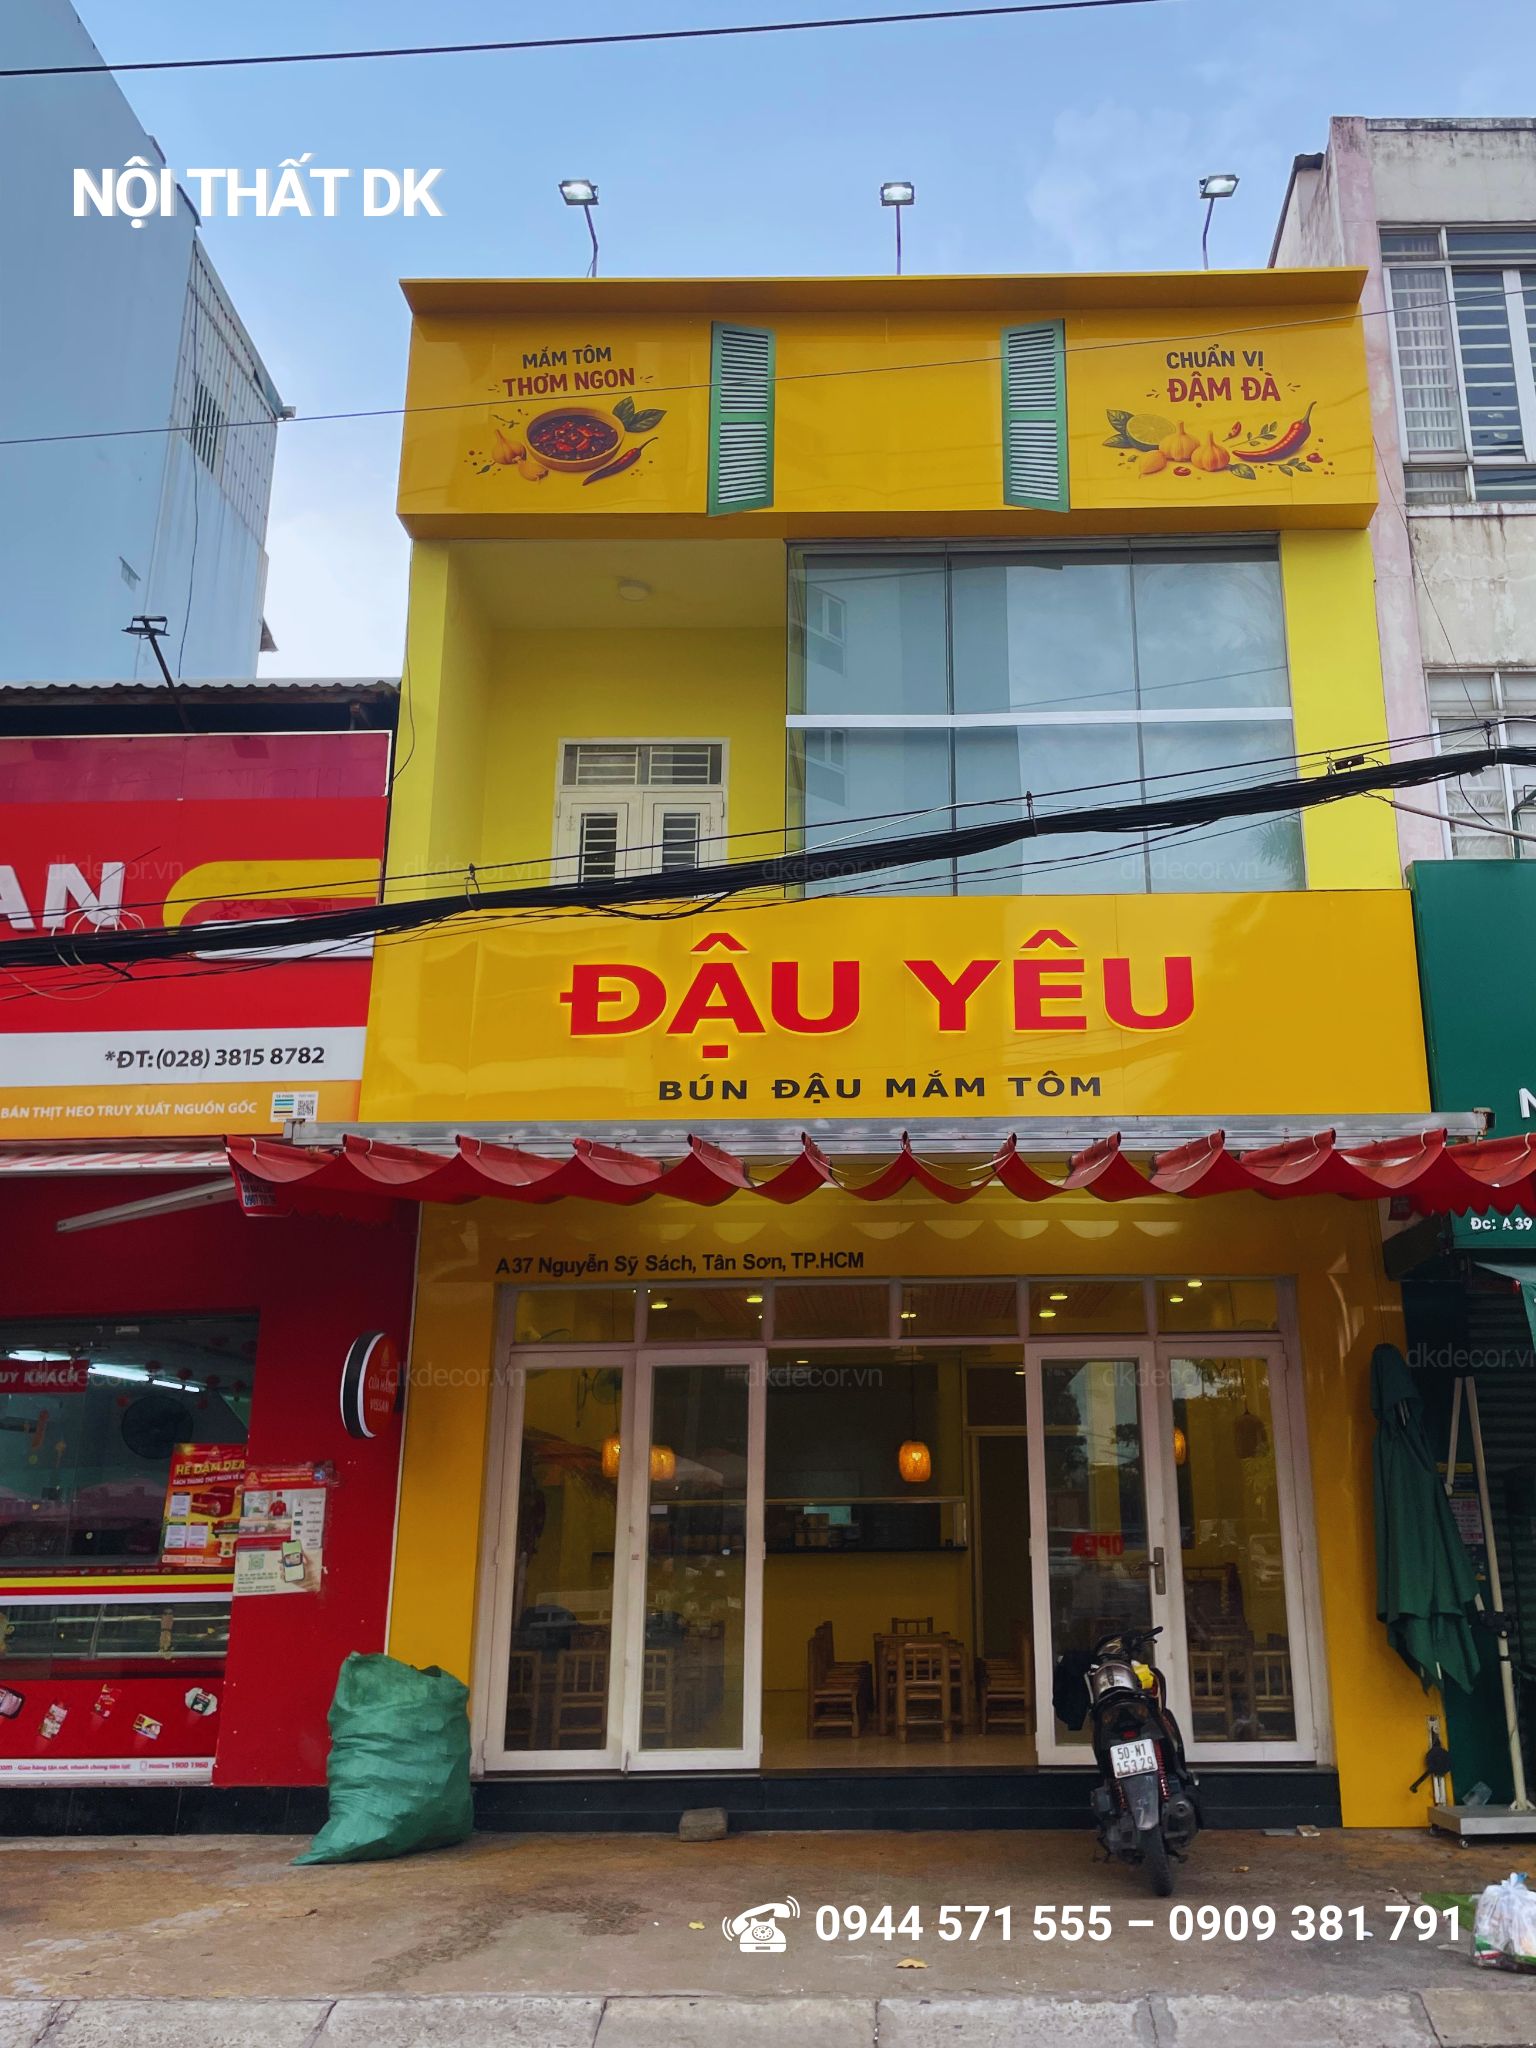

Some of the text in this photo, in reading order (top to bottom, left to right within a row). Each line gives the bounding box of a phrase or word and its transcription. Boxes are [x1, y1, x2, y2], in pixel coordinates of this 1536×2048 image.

[522, 344, 612, 369] MẮM TÔM
[1166, 343, 1264, 371] CHUẨN VỊ
[502, 367, 636, 397] THƠM NGON
[1166, 371, 1281, 408] ĐẬM ĐÀ
[560, 929, 1196, 1060] ĐẬU YÊU
[214, 1048, 264, 1066] 3815
[270, 1046, 325, 1065] 8782
[658, 1070, 1102, 1103] BÚN ĐẬU MẮM TÔM
[32, 1105, 64, 1120] THỊT
[66, 1104, 95, 1118] HEO
[97, 1104, 133, 1117] TRUY
[135, 1100, 171, 1116] XUẤT
[228, 1099, 258, 1114] GỐC
[495, 1251, 864, 1277] A37 Nguyễn Sỹ Sách, Tân Sơn, TP.HCM
